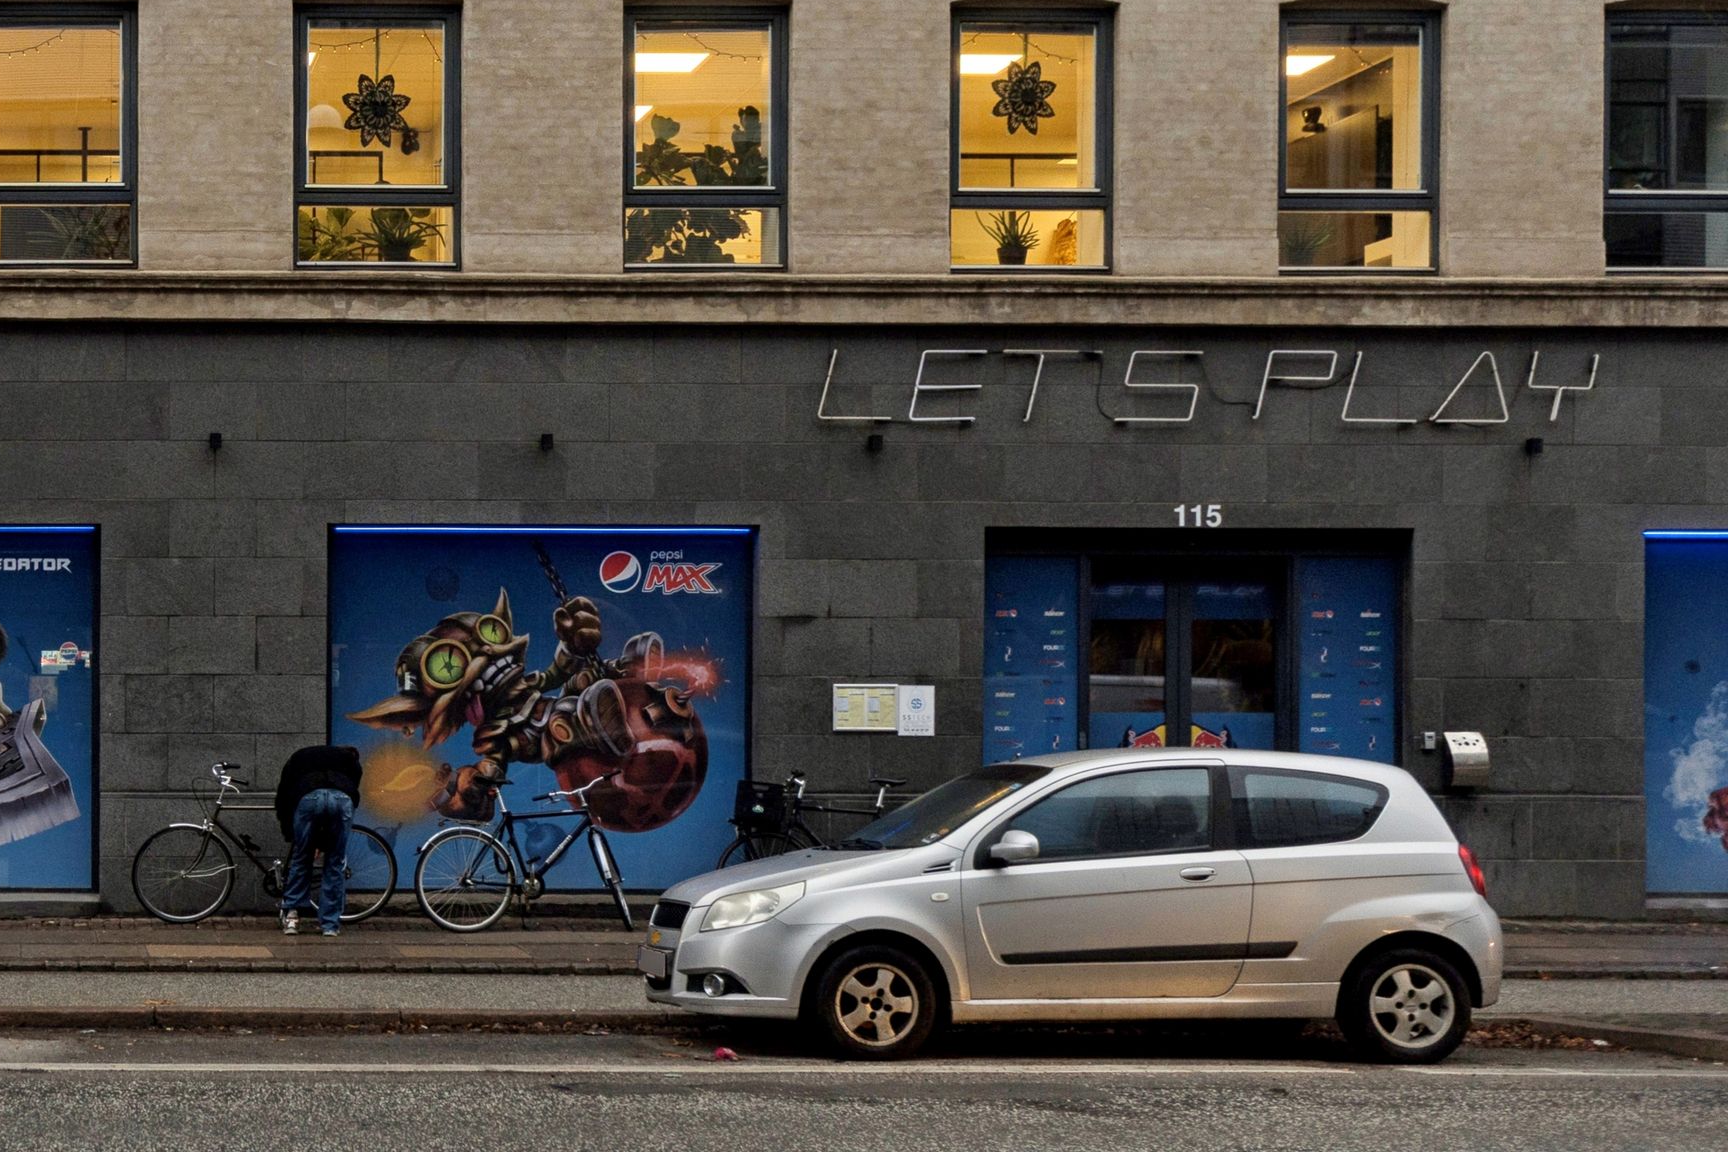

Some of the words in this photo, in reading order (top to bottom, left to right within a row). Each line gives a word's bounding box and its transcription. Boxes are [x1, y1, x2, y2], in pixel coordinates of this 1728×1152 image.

[1252, 349, 1600, 423] PLAY
[1173, 504, 1222, 528] 115
[650, 549, 683, 561] pepsi
[641, 562, 723, 595] MAX
